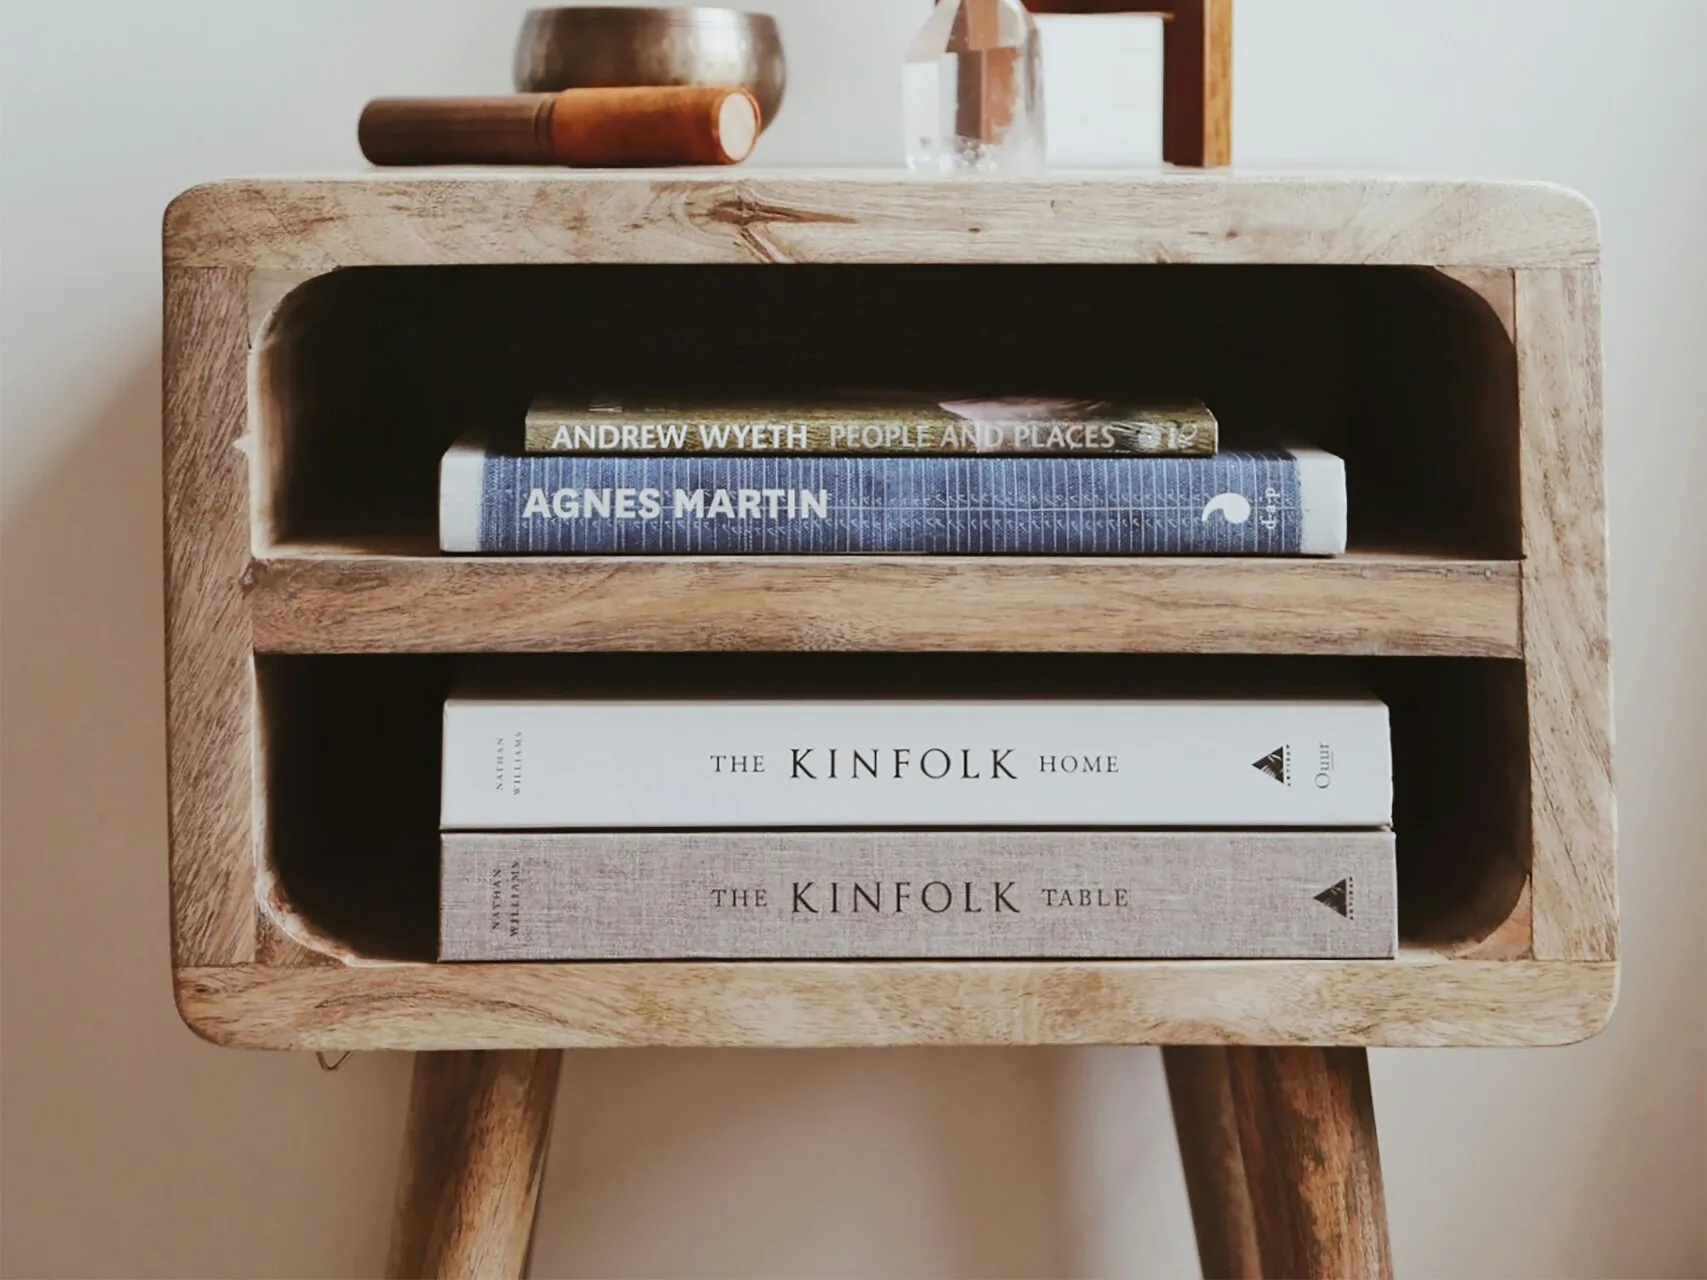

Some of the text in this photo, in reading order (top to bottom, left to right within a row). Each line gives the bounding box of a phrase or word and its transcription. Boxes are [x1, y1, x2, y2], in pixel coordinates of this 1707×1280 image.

[551, 423, 1115, 449] ANDREW WYETH PEOPLE AND PLACES
[522, 488, 828, 519] AGNES MARTIN
[495, 736, 505, 791] NATHAN
[512, 731, 523, 796] WILLIAMS
[710, 748, 1120, 779] THE KINFOLK HOME
[1314, 742, 1332, 789] Ouur
[491, 868, 502, 931] NATHAN
[509, 860, 521, 937] WILLIAMS
[711, 881, 1130, 914] THE KINFOLK TABLE
